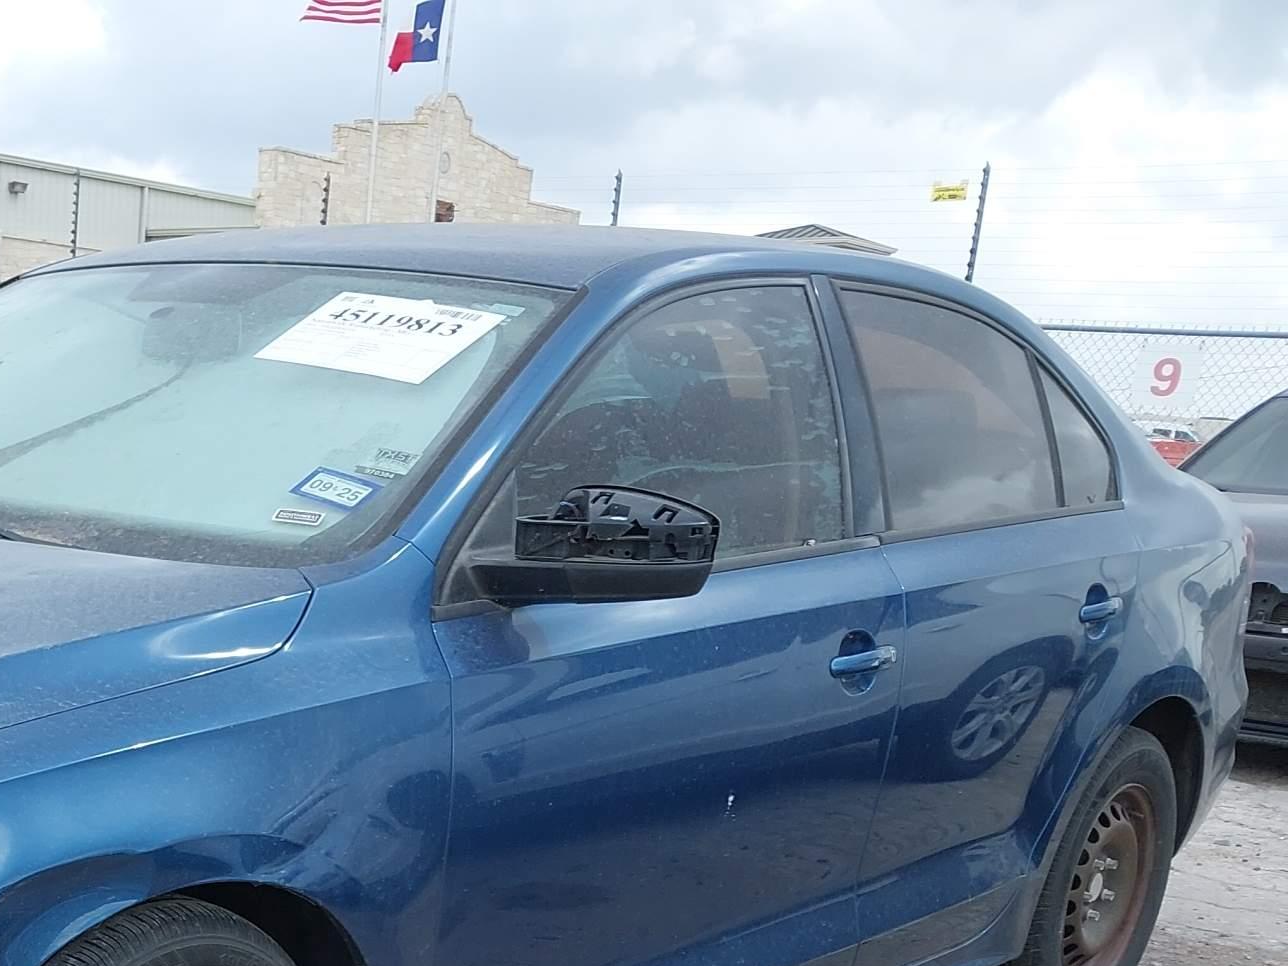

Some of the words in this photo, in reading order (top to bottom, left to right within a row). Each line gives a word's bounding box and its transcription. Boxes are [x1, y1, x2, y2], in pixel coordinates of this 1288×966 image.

[329, 307, 463, 337] 45119813
[1150, 357, 1182, 396] 9
[310, 479, 333, 492] 09
[336, 487, 364, 502] 25
